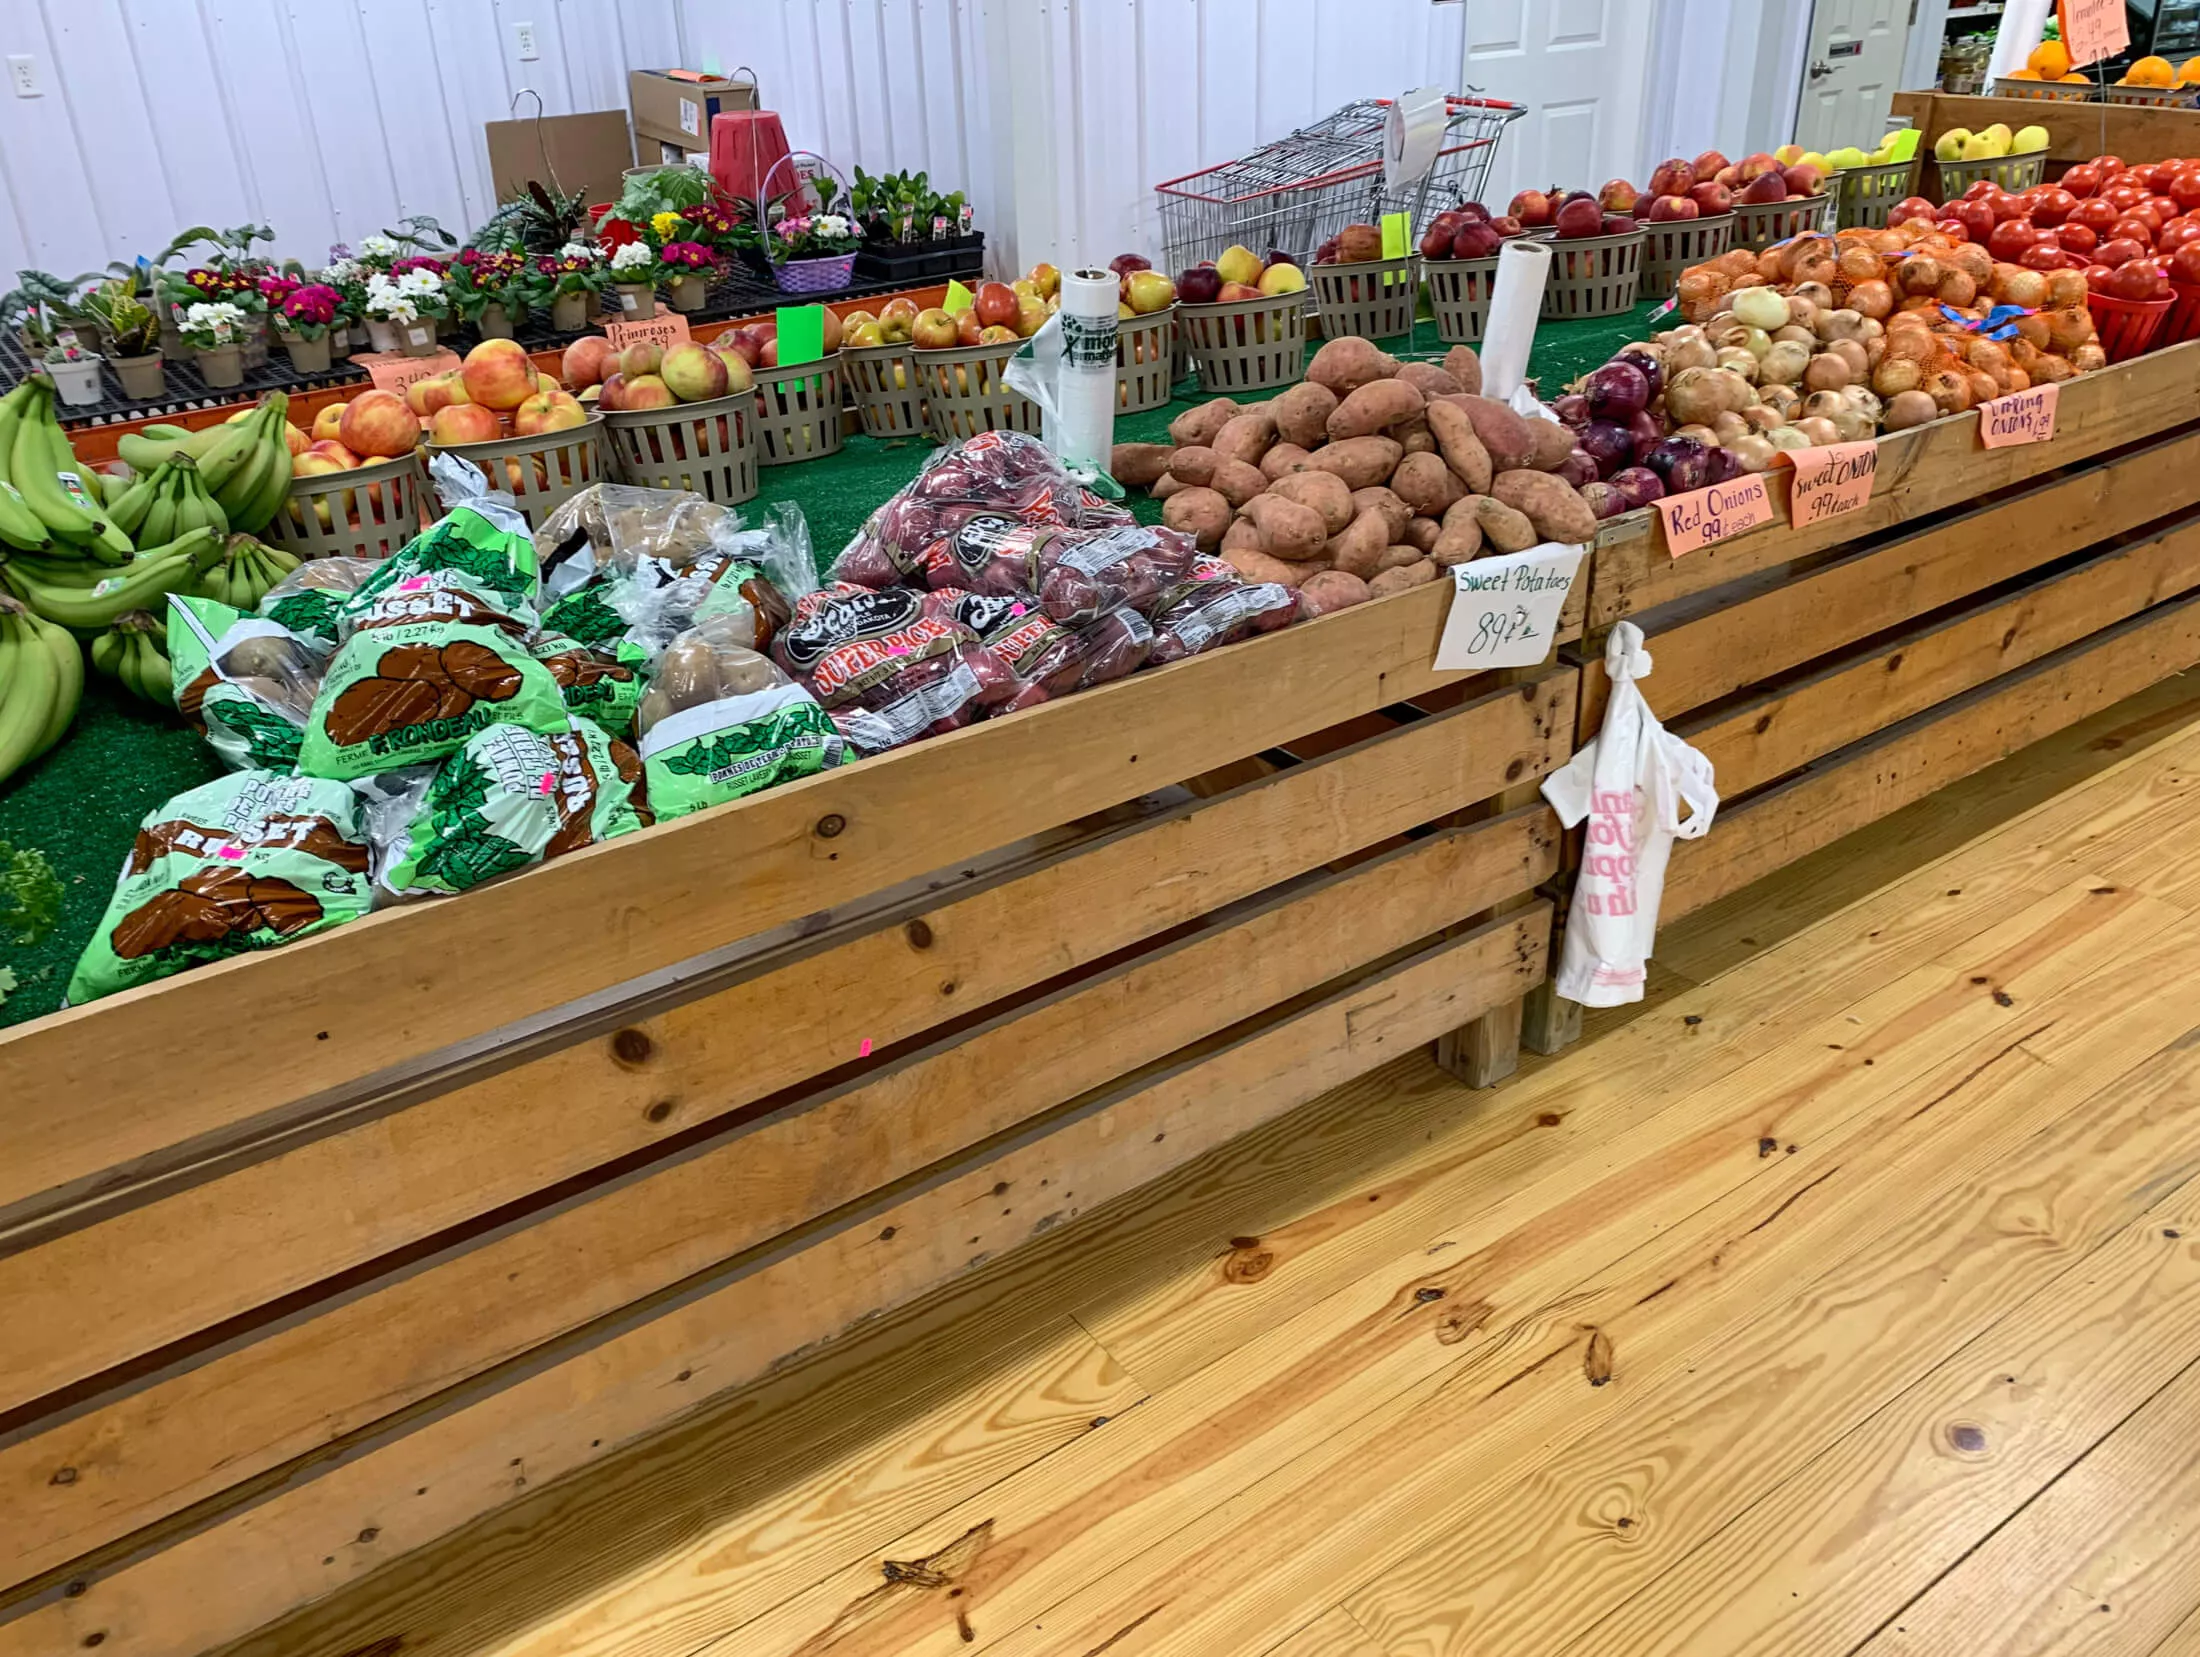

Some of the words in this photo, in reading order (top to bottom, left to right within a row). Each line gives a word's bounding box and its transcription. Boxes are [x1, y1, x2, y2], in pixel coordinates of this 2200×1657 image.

[611, 324, 677, 346] Primroses
[1670, 500, 1702, 537] Red
[1706, 482, 1763, 517] Onions
[1459, 567, 1509, 593] Sweet
[1513, 564, 1571, 593] Potatoes
[404, 625, 430, 638] 2.27
[812, 639, 890, 696] SUPER
[884, 616, 953, 651] PACK
[389, 707, 493, 747] RONDEAU
